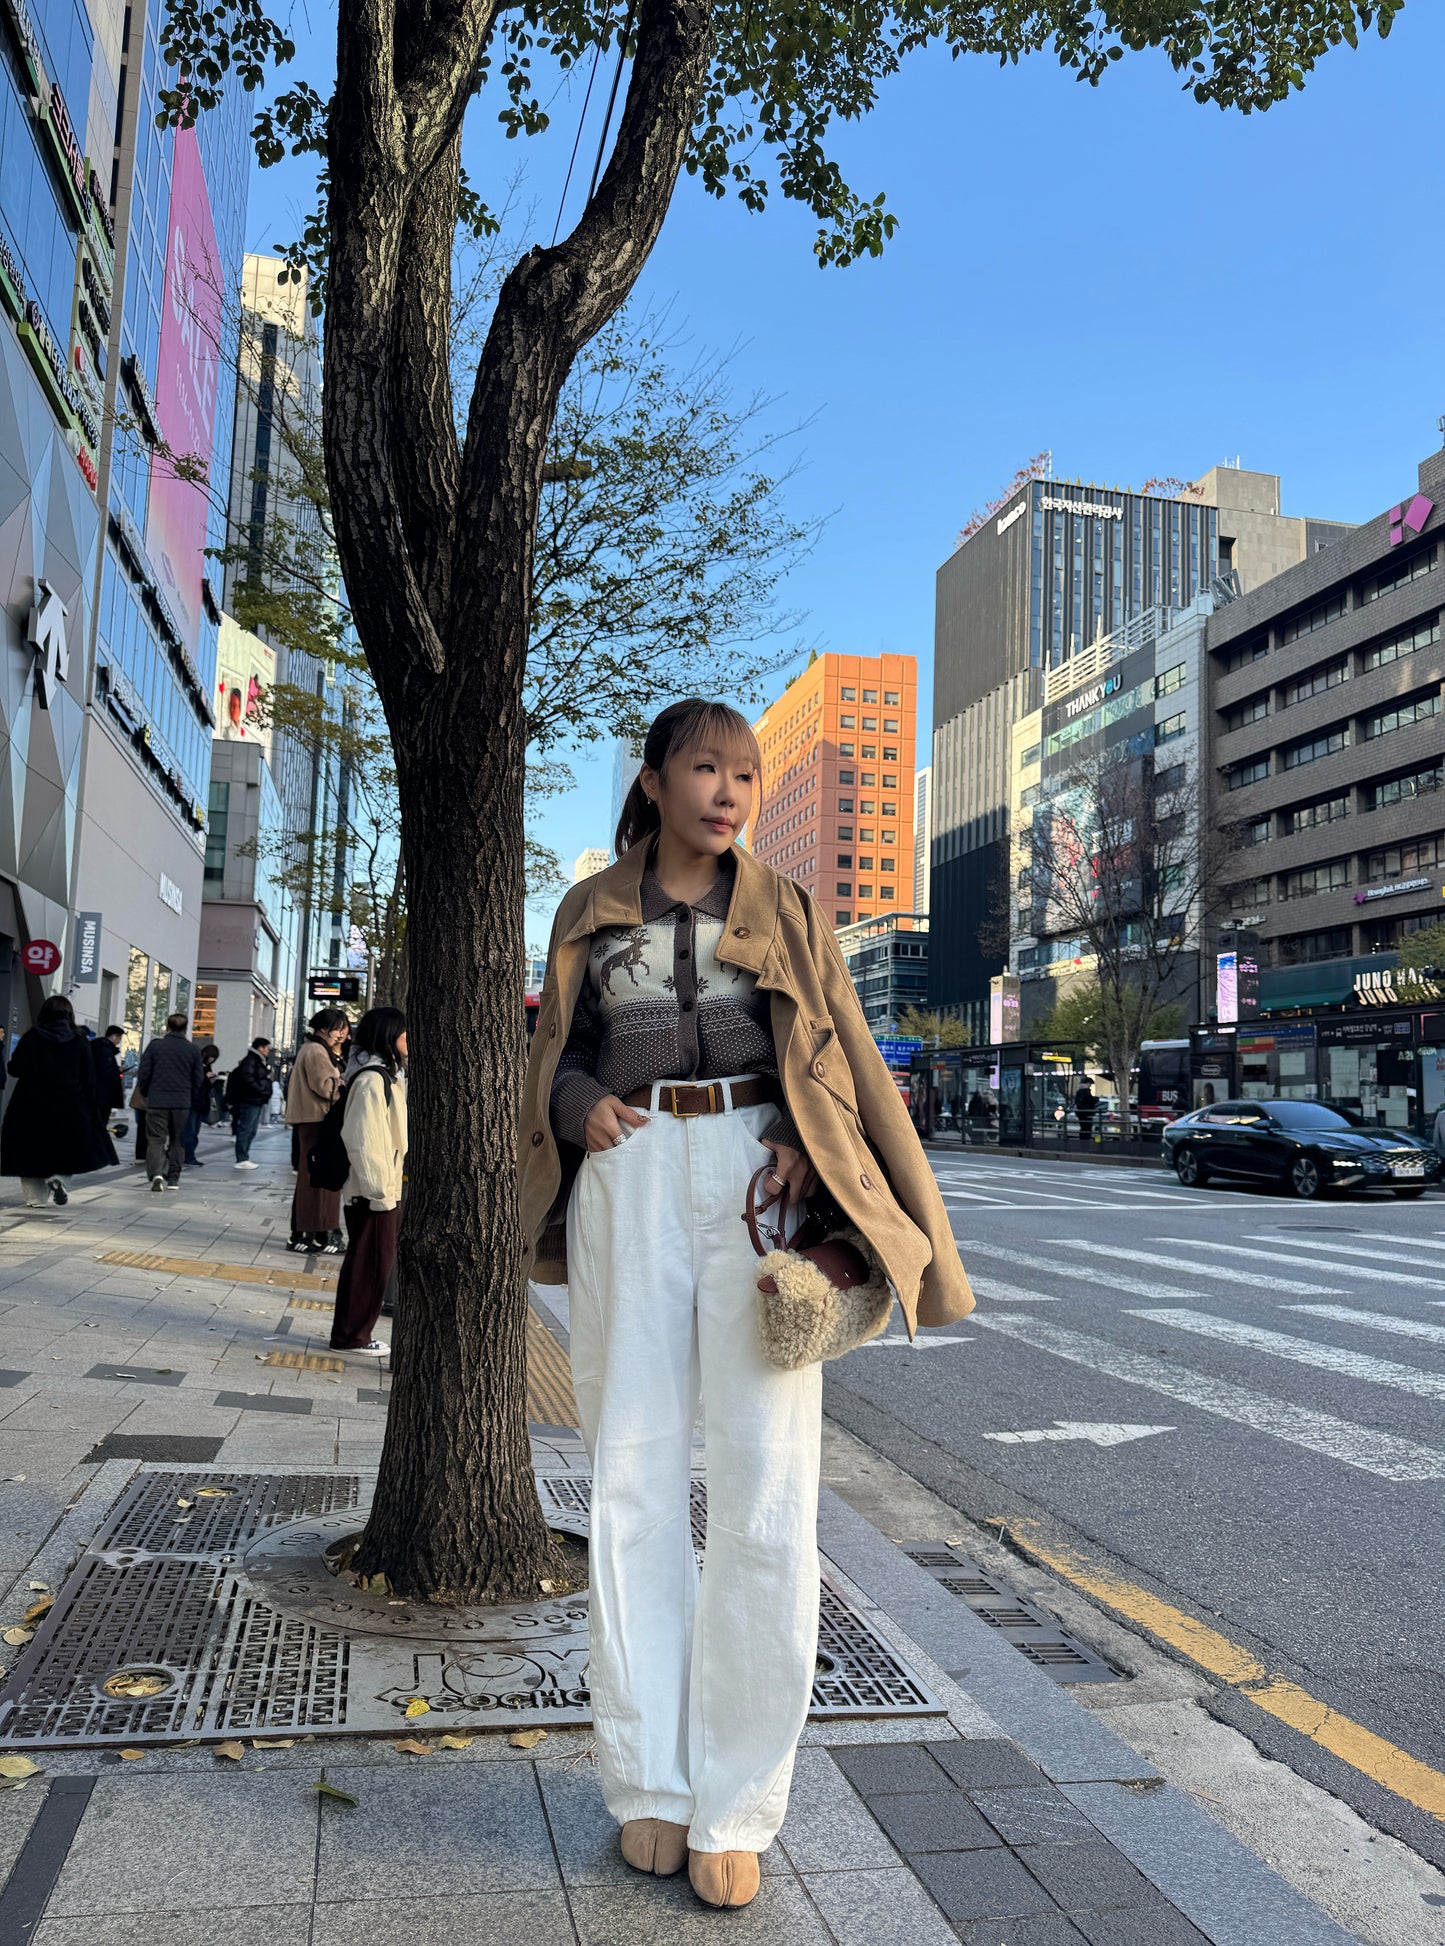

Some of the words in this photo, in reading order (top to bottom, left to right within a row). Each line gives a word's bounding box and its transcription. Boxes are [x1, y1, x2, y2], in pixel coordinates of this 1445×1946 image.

[170, 224, 214, 440] SALE
[1041, 496, 1124, 521] 한국자산관리공사
[1065, 684, 1100, 718] THANK
[159, 872, 183, 916] MUSINSA
[27, 946, 53, 970] 약
[80, 919, 97, 975] MUSINSA
[1353, 970, 1392, 992] JUNO
[1358, 987, 1398, 1006] JUNO
[440, 1615, 485, 1630] to
[510, 1610, 589, 1628] Seo
